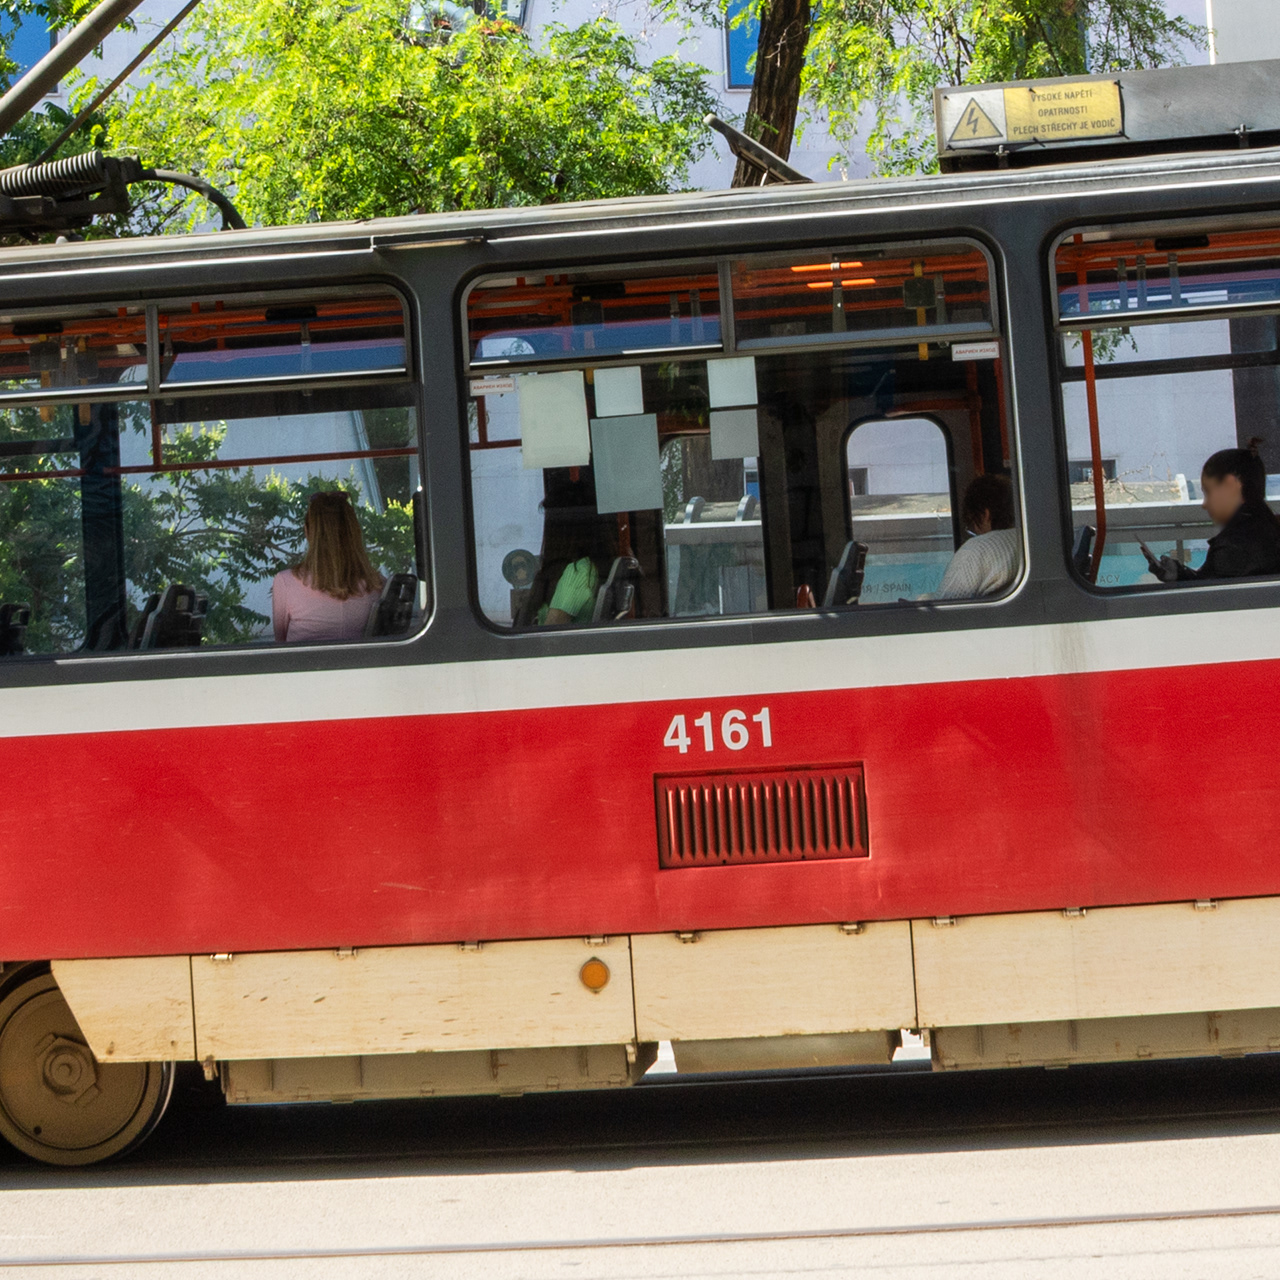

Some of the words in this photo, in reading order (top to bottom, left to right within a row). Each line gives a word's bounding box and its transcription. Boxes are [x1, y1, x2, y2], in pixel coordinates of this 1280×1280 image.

[1031, 91, 1062, 103] VYSOKÉ
[1013, 124, 1039, 135] PLECH
[1041, 121, 1077, 134] STŘECHY
[1079, 120, 1089, 130] JE
[1090, 118, 1115, 129] VODIČ
[882, 583, 912, 593] SPAIN
[663, 706, 773, 754] 4161
